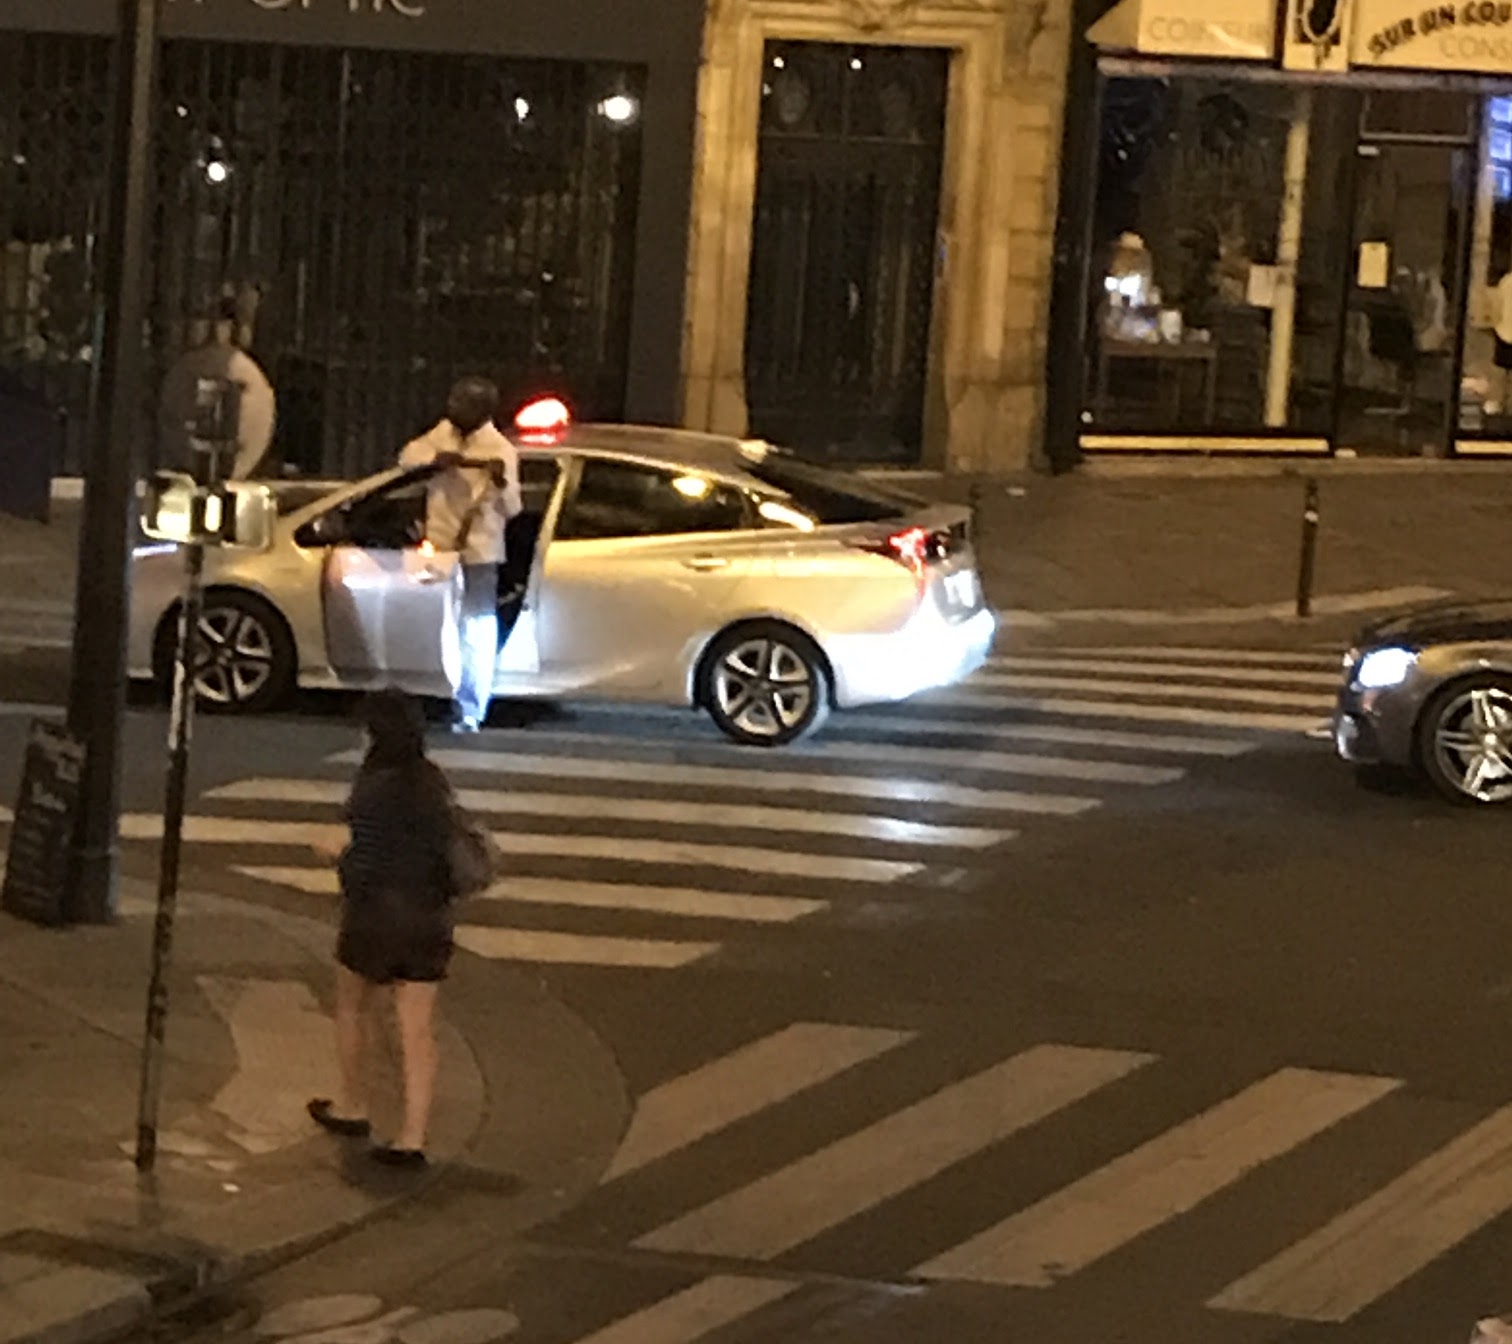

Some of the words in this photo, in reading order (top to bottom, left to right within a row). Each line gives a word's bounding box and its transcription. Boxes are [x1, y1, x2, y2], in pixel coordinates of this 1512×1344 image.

[1367, 17, 1417, 56] SUR
[1418, 3, 1457, 36] UN
[1459, 0, 1512, 27] COU
